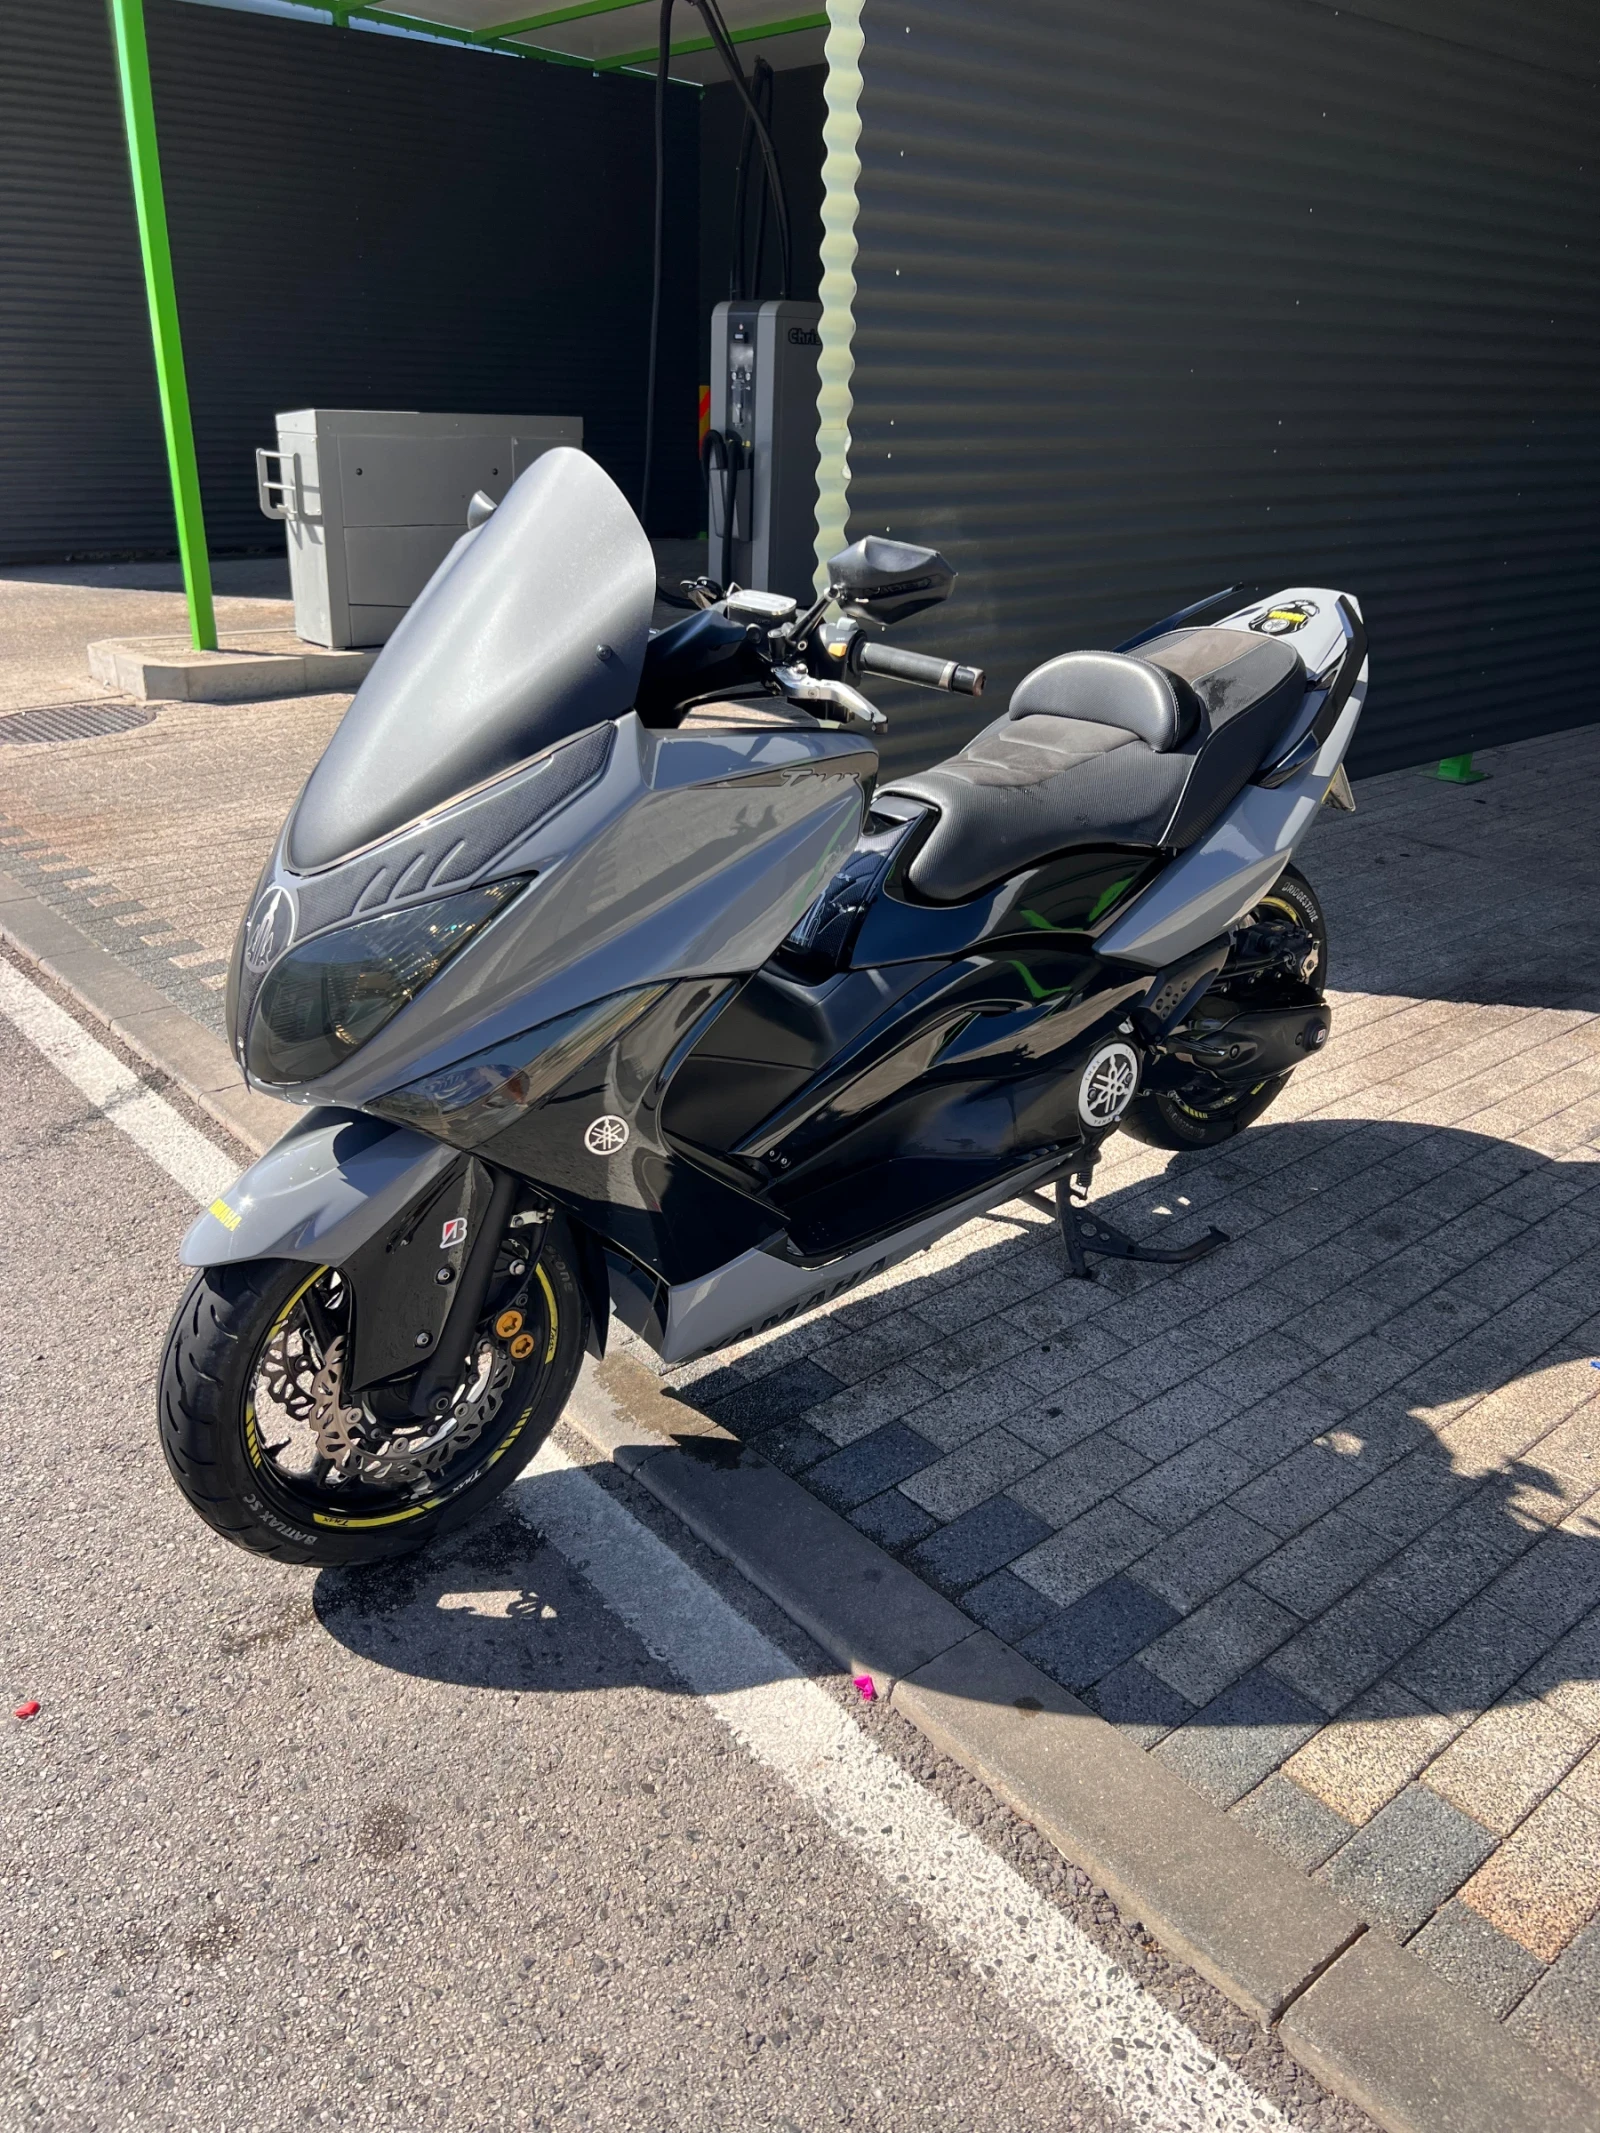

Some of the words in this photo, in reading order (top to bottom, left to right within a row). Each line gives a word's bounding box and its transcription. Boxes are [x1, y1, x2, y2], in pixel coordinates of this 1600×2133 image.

[1281, 881, 1319, 923] BRIDGESTONE
[1093, 1110, 1121, 1125] YAMAA
[243, 1493, 264, 1512] SC
[260, 1510, 318, 1546] BATTLAX
